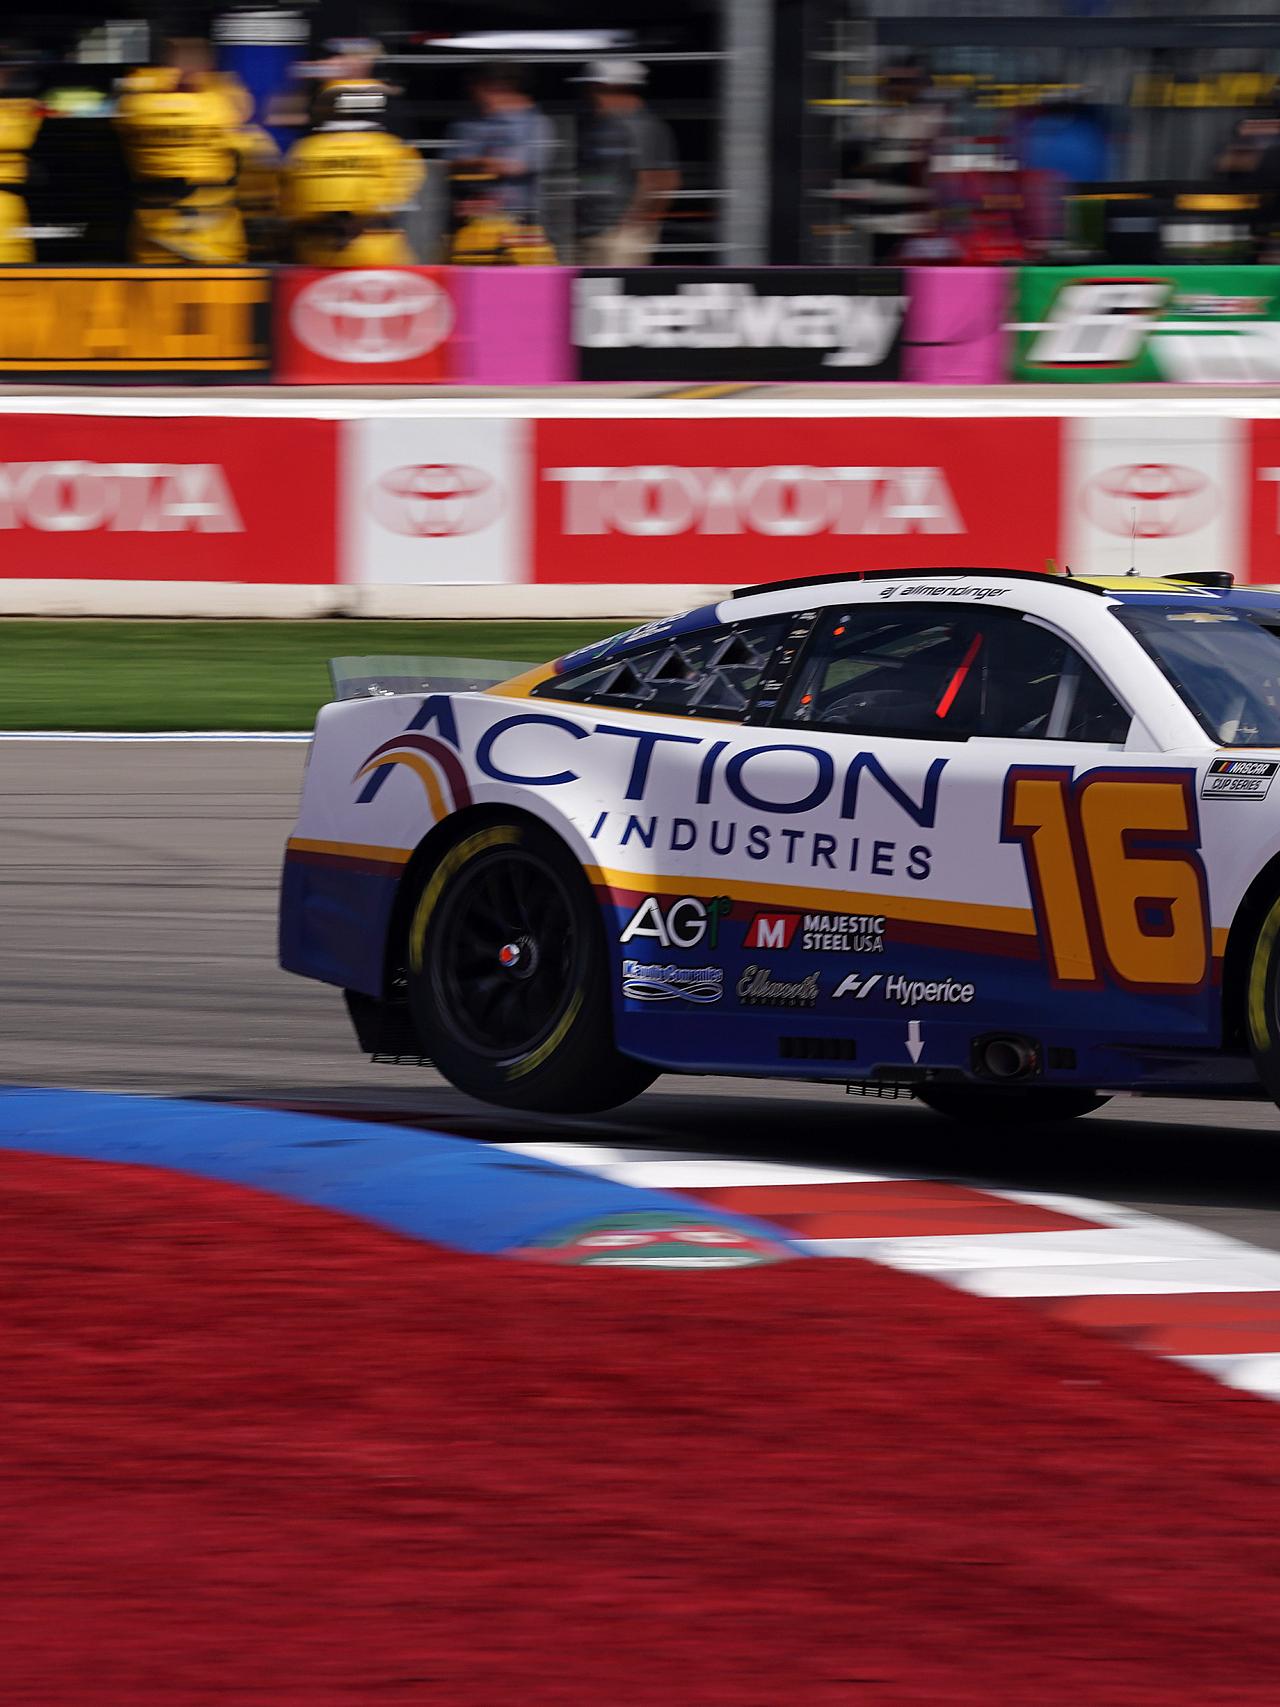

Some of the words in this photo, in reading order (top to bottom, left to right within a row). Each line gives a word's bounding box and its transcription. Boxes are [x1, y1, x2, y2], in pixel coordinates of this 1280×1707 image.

[570, 277, 911, 367] betway
[541, 464, 968, 536] TOYOTA
[900, 584, 1013, 600] allmendinger
[354, 694, 951, 830] ACTION
[1229, 762, 1270, 775] NASCAR
[1211, 777, 1232, 790] CUP
[1232, 778, 1262, 791] SERIES
[589, 811, 933, 881] INDUSTRIES
[1000, 764, 1212, 995] 16
[756, 918, 786, 949] M
[802, 914, 886, 934] MAJESTIC
[802, 933, 851, 951] STEEL
[853, 935, 884, 953] USA
[885, 974, 975, 1006] Hyperice
